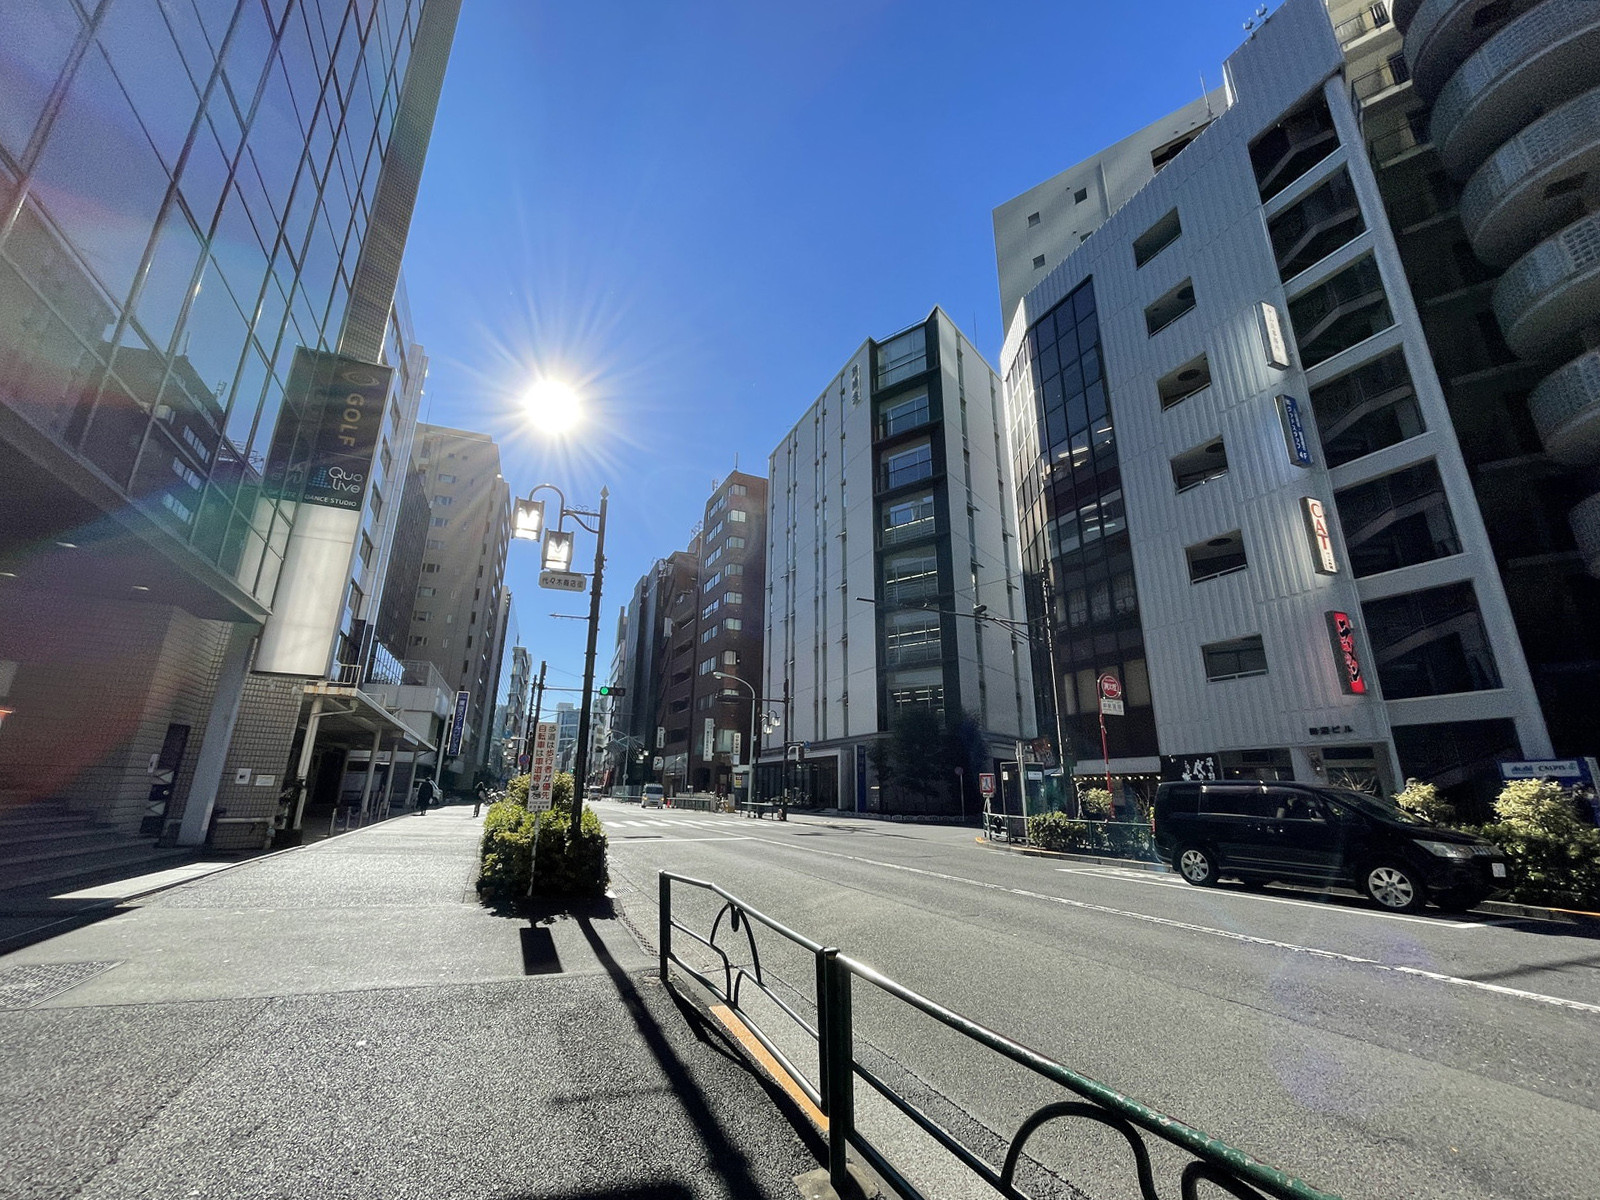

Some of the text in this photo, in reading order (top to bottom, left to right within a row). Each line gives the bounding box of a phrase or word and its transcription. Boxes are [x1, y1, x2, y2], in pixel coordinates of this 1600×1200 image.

[338, 393, 365, 447] GOLF
[328, 466, 363, 481] Quo
[304, 494, 357, 507] DANCE STUDIO
[1311, 503, 1329, 550] CAT
[541, 725, 557, 800] 歩道は歩行者が優先
